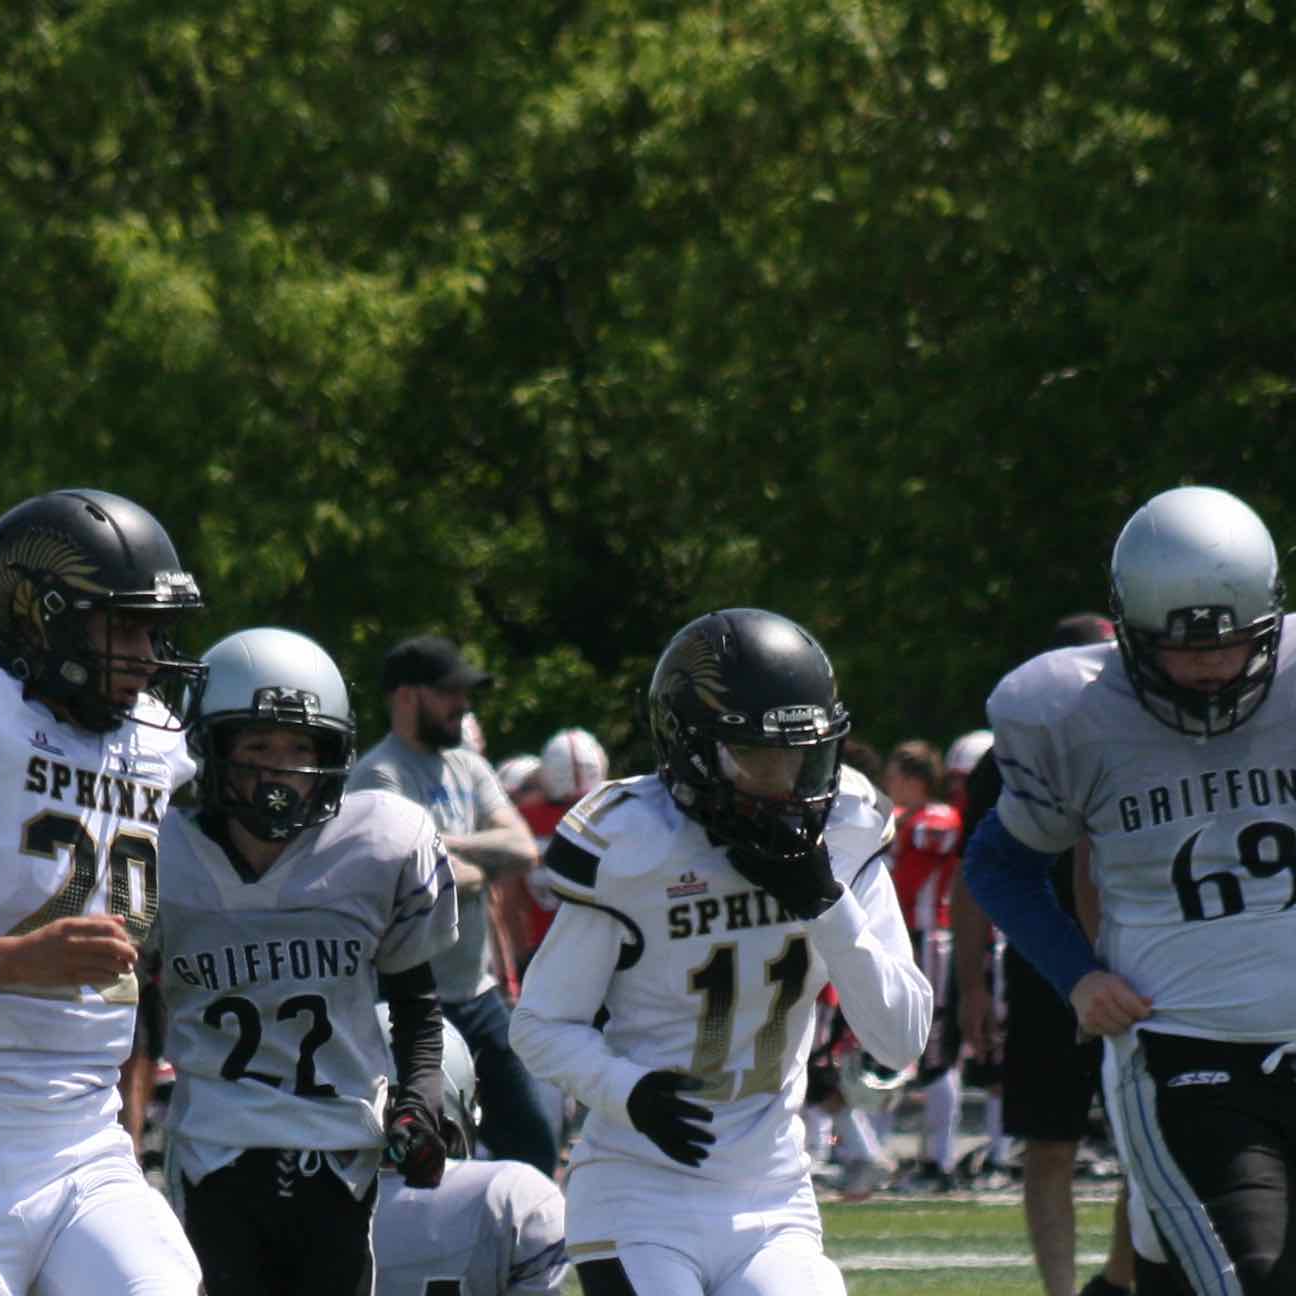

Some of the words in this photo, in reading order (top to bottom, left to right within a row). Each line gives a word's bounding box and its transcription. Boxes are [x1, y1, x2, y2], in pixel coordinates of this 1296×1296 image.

[24, 755, 162, 825] SPHINX
[668, 887, 798, 940] SPHI
[172, 939, 362, 990] GRIFFONS
[204, 994, 339, 1098] 22
[688, 932, 812, 1098] 11
